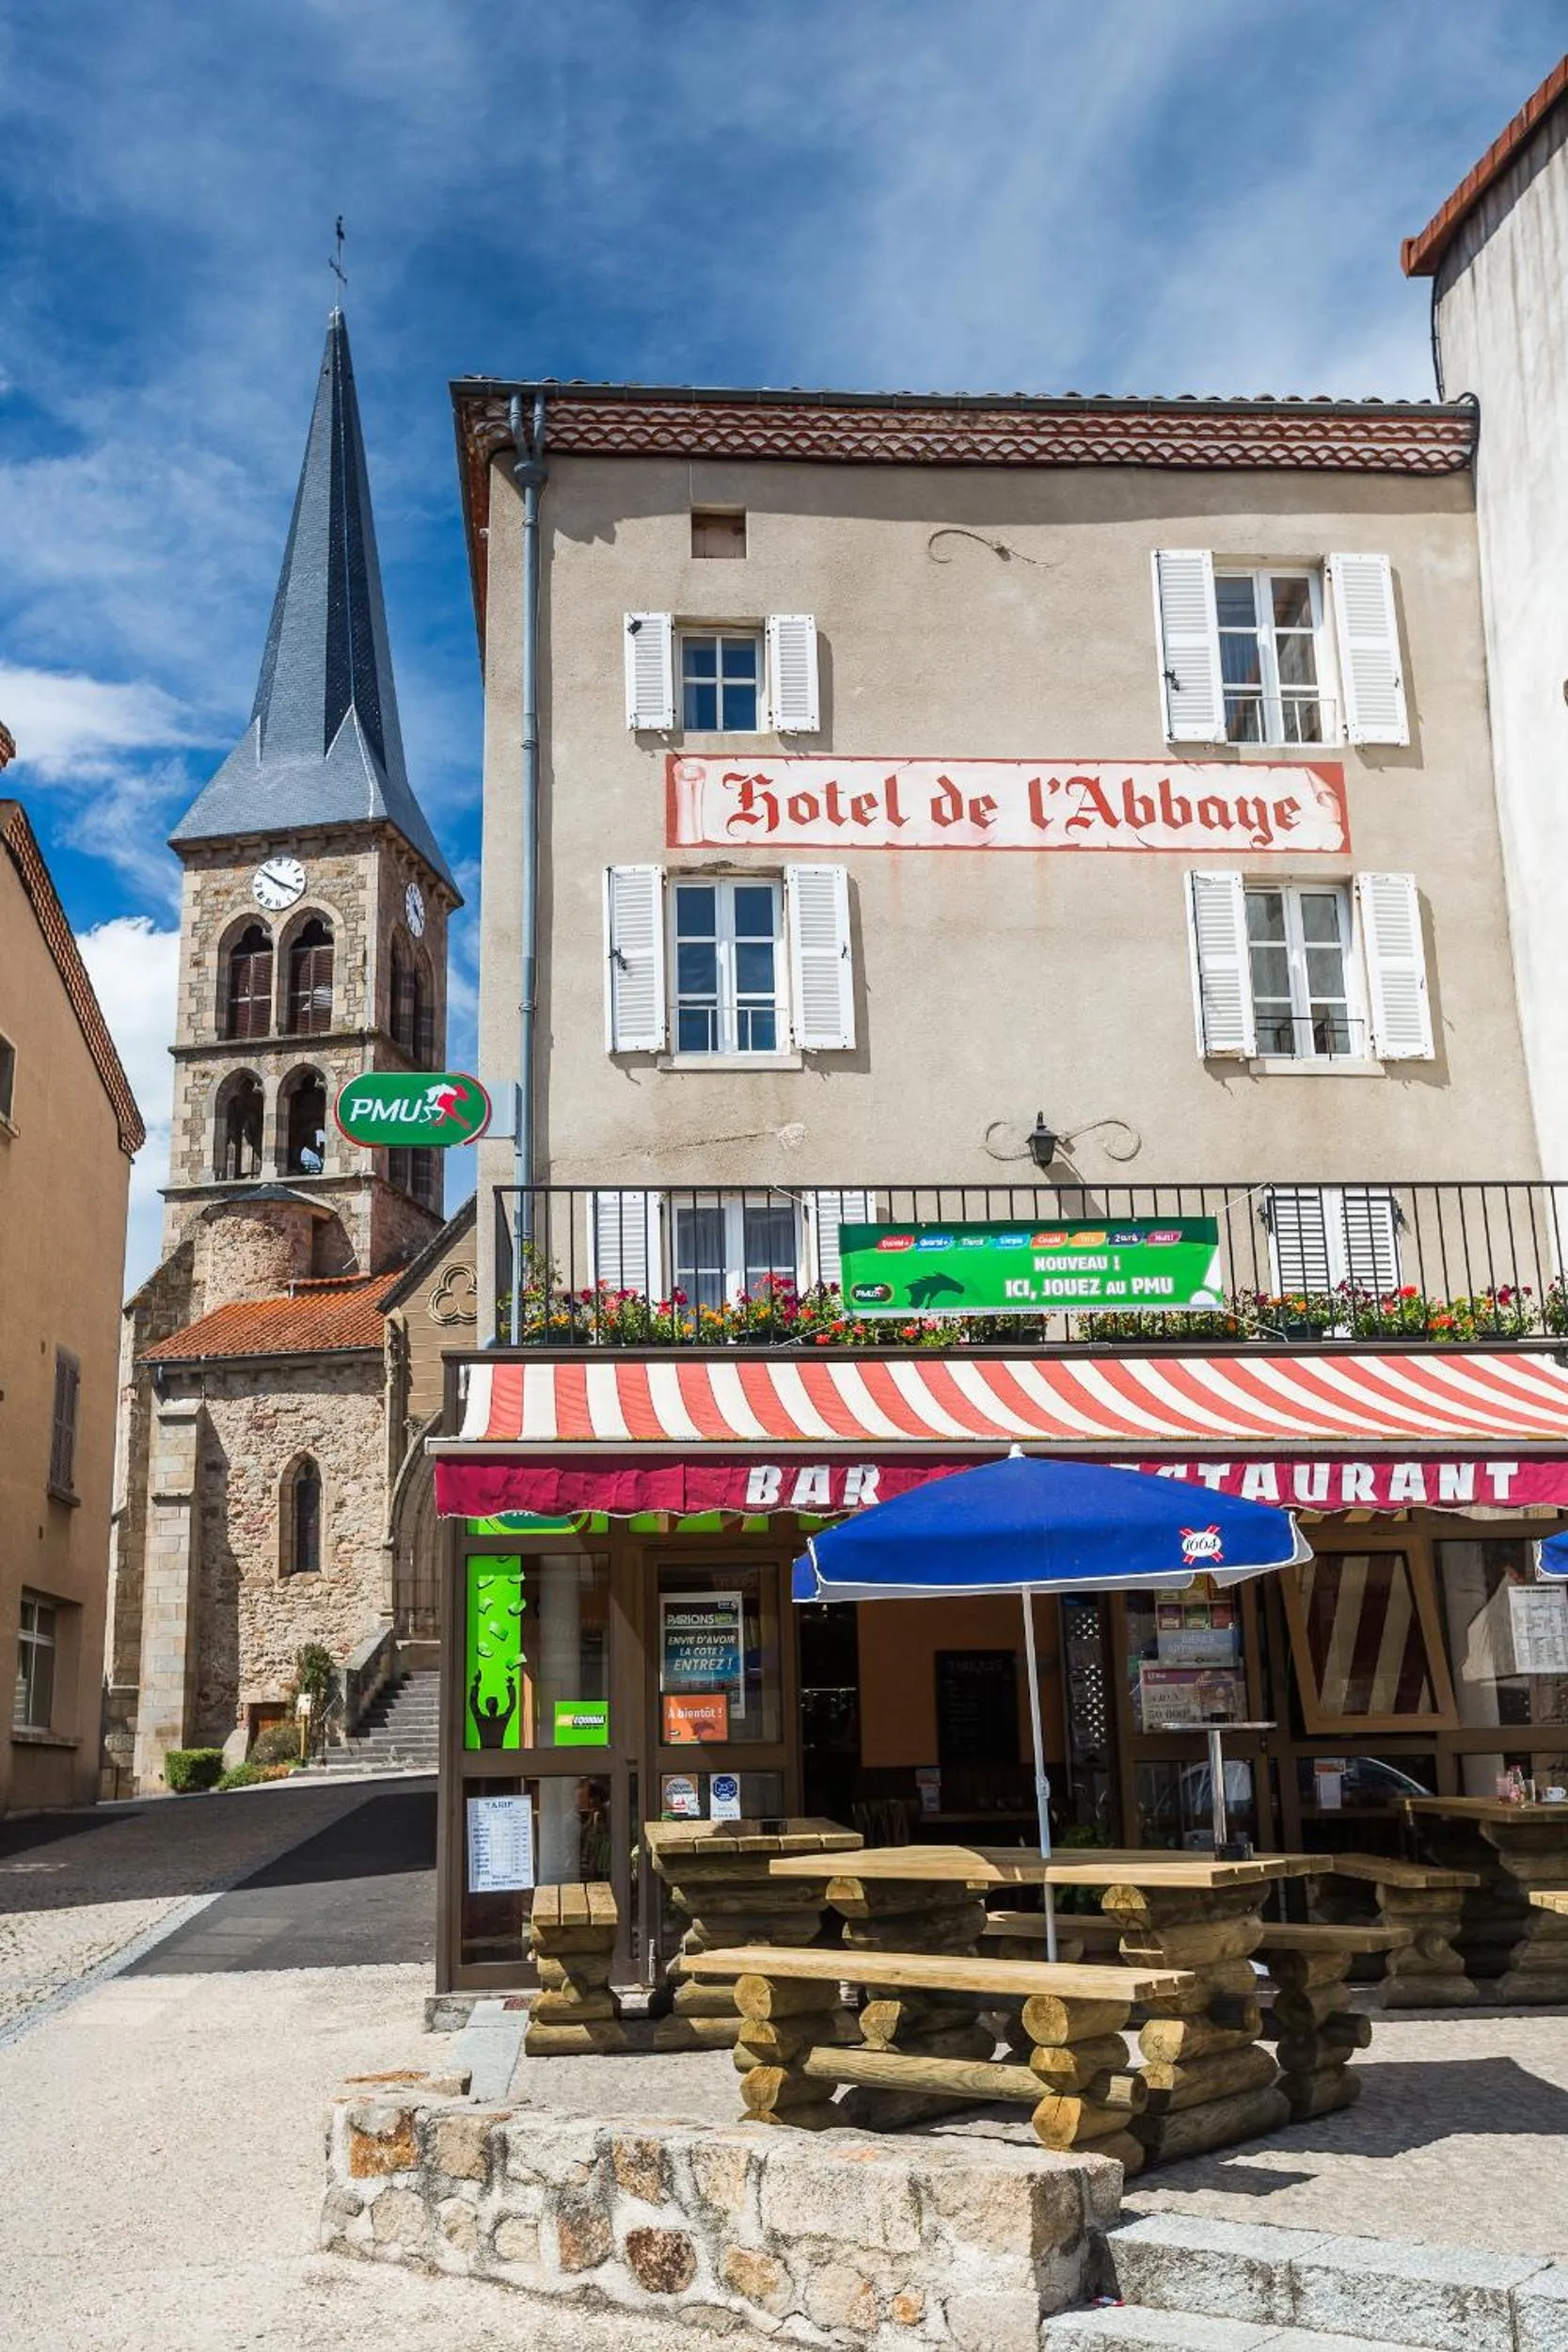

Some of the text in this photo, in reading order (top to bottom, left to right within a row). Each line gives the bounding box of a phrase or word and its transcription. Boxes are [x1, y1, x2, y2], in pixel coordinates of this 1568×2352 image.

[722, 772, 1302, 846] Hotel de l'Abbaye
[350, 1098, 423, 1122] PMU
[1034, 1256, 1107, 1272] NOUVEAU
[1006, 1277, 1174, 1299] ICI, JOUEZ AU PMU
[746, 1464, 880, 1505] BAR
[1110, 1461, 1519, 1502] TAURANT
[1186, 1537, 1216, 1551] 1664
[667, 1613, 715, 1625] PARIONS
[696, 1635, 736, 1645] D'AVOIR
[679, 1647, 691, 1656] LA
[673, 1658, 725, 1671] ENTREZ
[677, 1706, 716, 1719] bientôt
